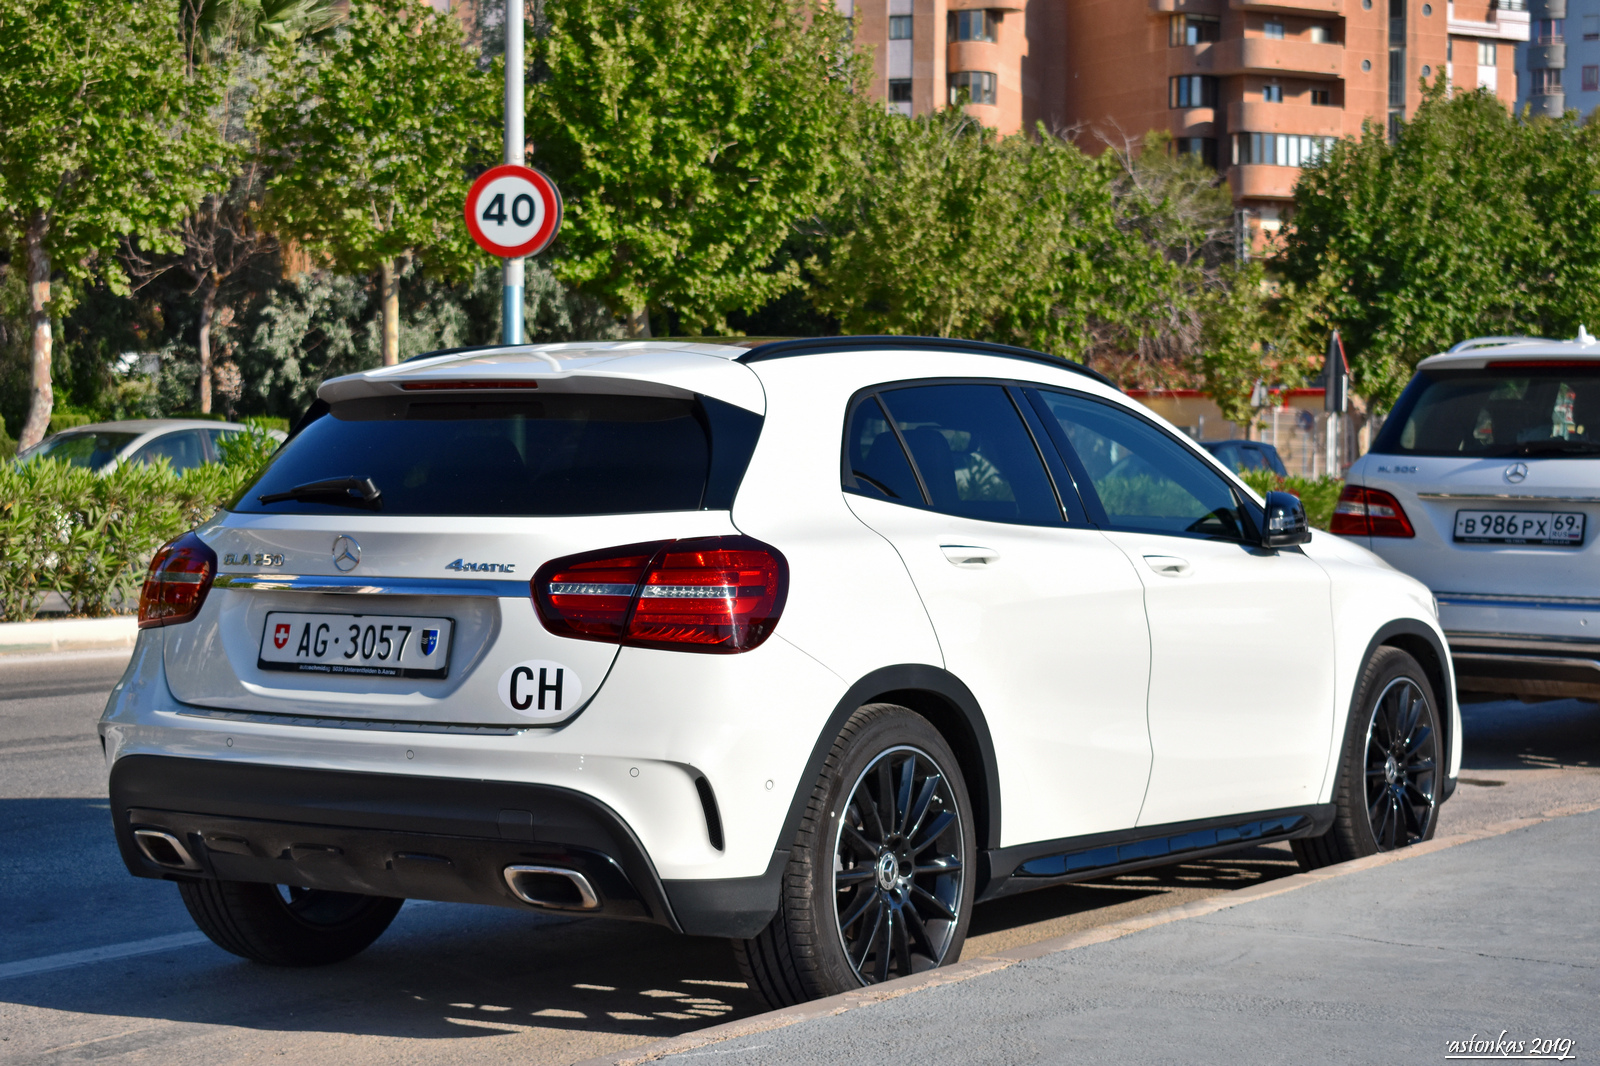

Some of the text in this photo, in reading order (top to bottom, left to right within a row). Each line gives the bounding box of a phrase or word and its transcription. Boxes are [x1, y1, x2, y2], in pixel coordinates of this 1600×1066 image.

[482, 193, 536, 227] 40
[1554, 515, 1576, 531] 69
[223, 552, 285, 567] GLA 250
[444, 558, 516, 574] 4MATIC
[509, 666, 564, 711] CH
